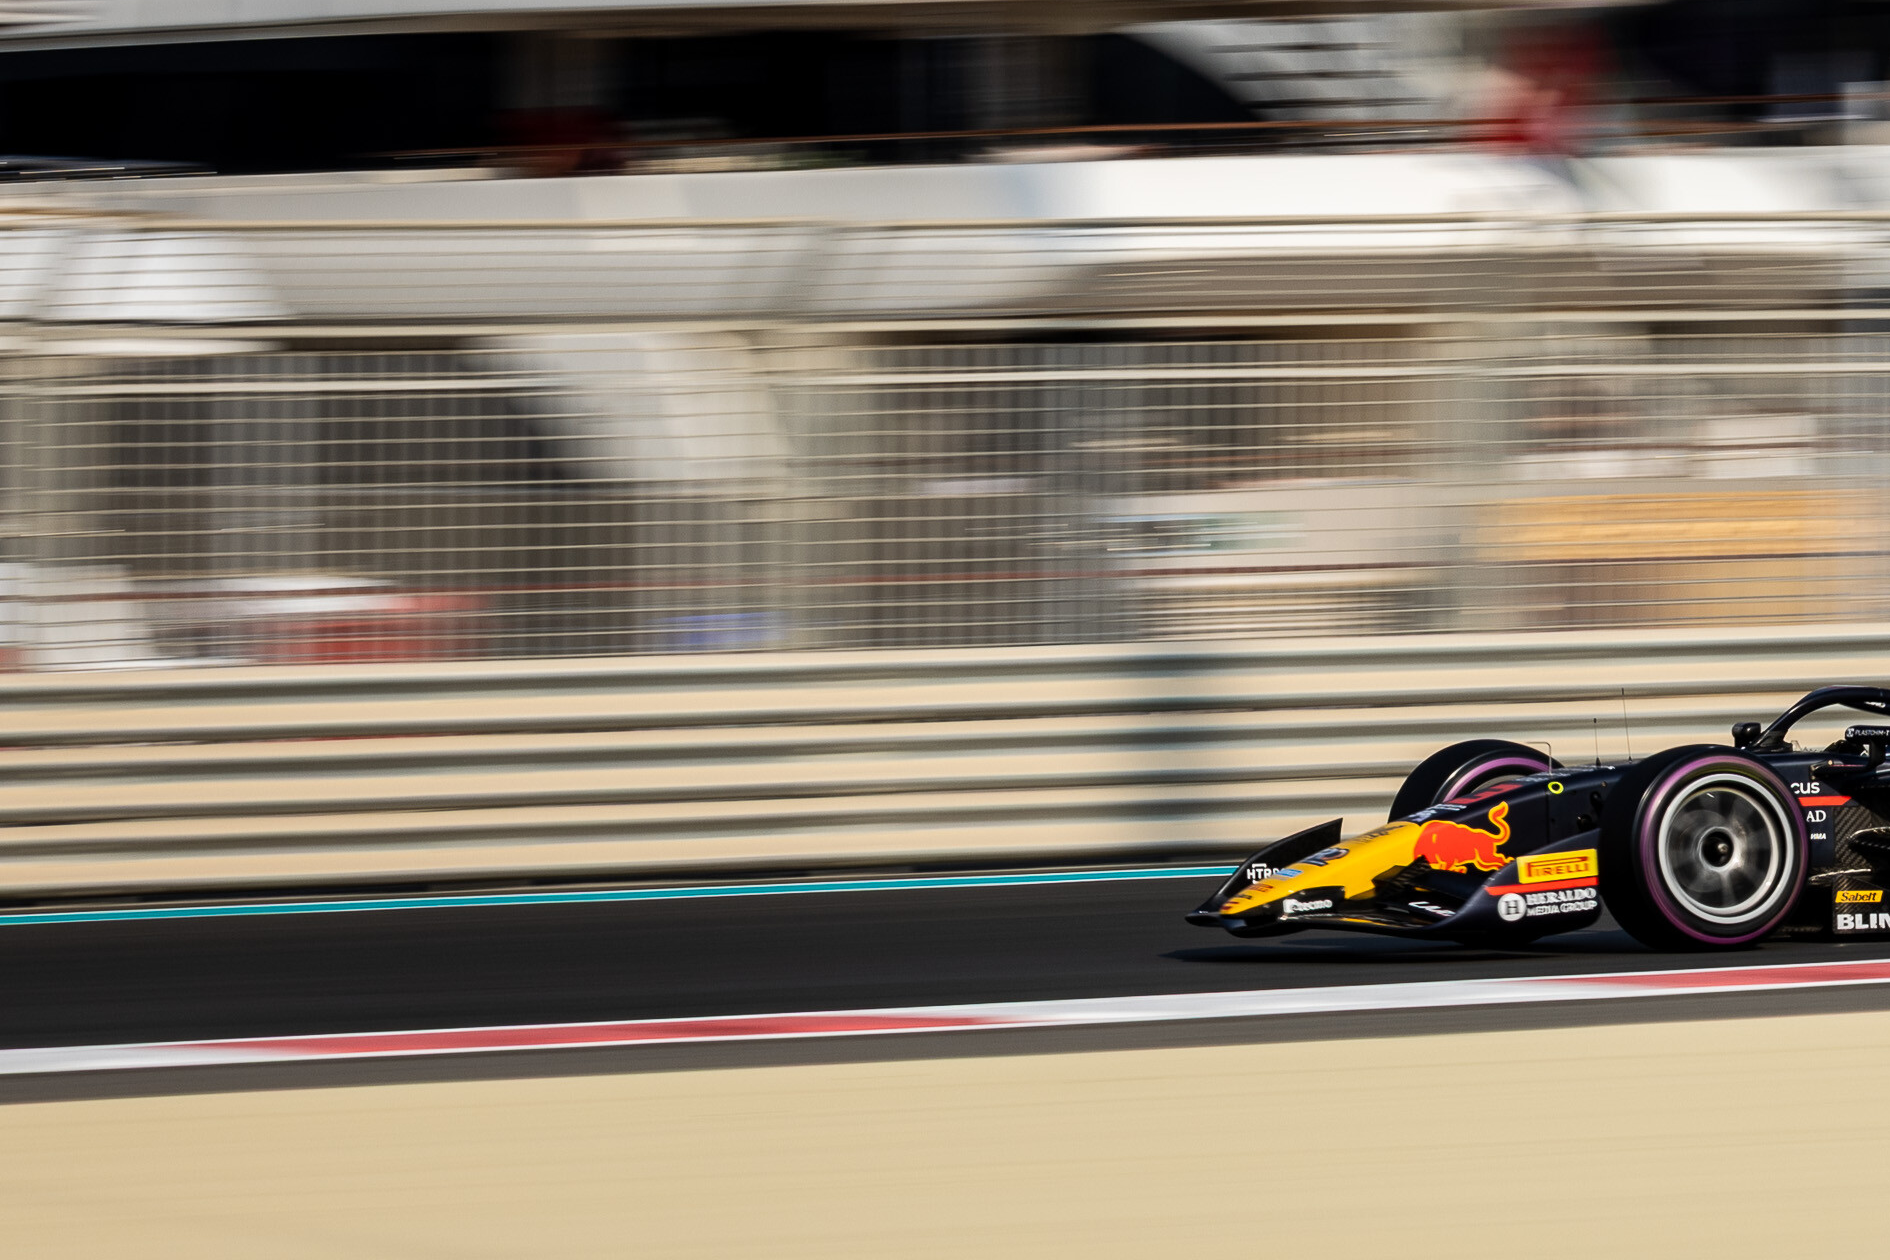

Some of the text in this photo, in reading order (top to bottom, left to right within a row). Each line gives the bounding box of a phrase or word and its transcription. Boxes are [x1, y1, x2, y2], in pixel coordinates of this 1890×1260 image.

[1527, 856, 1589, 878] PIRELLI
[1525, 888, 1597, 906] HERALDO
[1840, 891, 1877, 902] Sabelt
[1527, 900, 1598, 917] MEDIA GROUP
